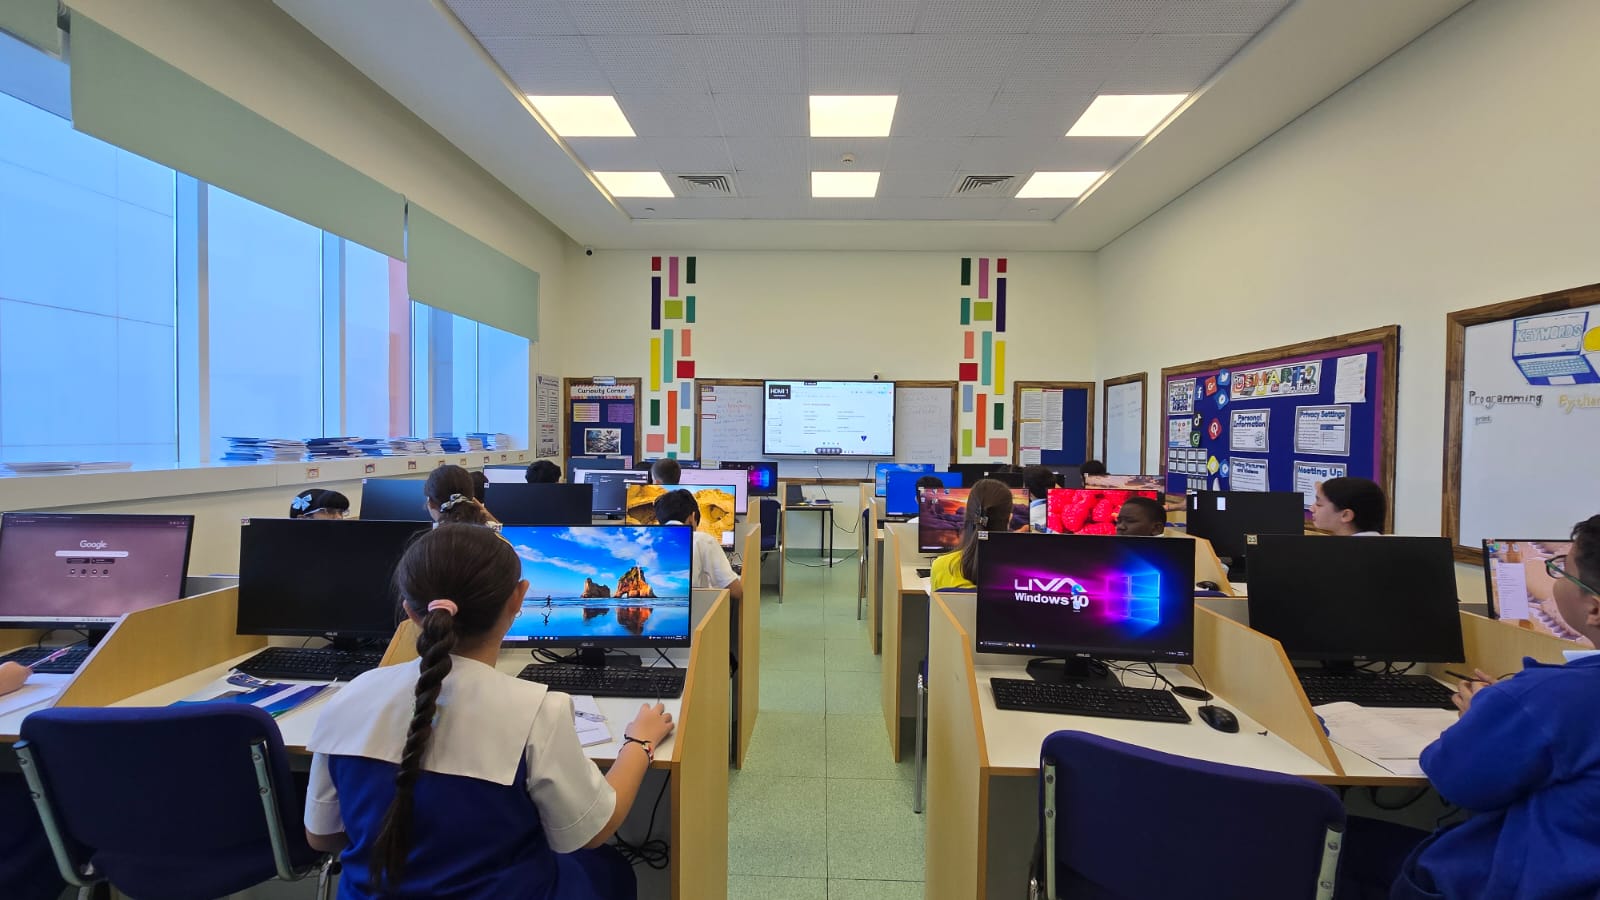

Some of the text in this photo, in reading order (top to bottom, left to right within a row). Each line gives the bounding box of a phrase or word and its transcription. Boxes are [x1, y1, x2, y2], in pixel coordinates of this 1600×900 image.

[1517, 324, 1583, 343] KEYWORDS
[1468, 390, 1543, 409] Programming
[1300, 411, 1345, 420] Privacy Settings
[1298, 466, 1343, 477] Meeting Up
[79, 540, 108, 550] Google
[1014, 578, 1087, 592] LIVA
[1015, 592, 1089, 607] Windows 10
